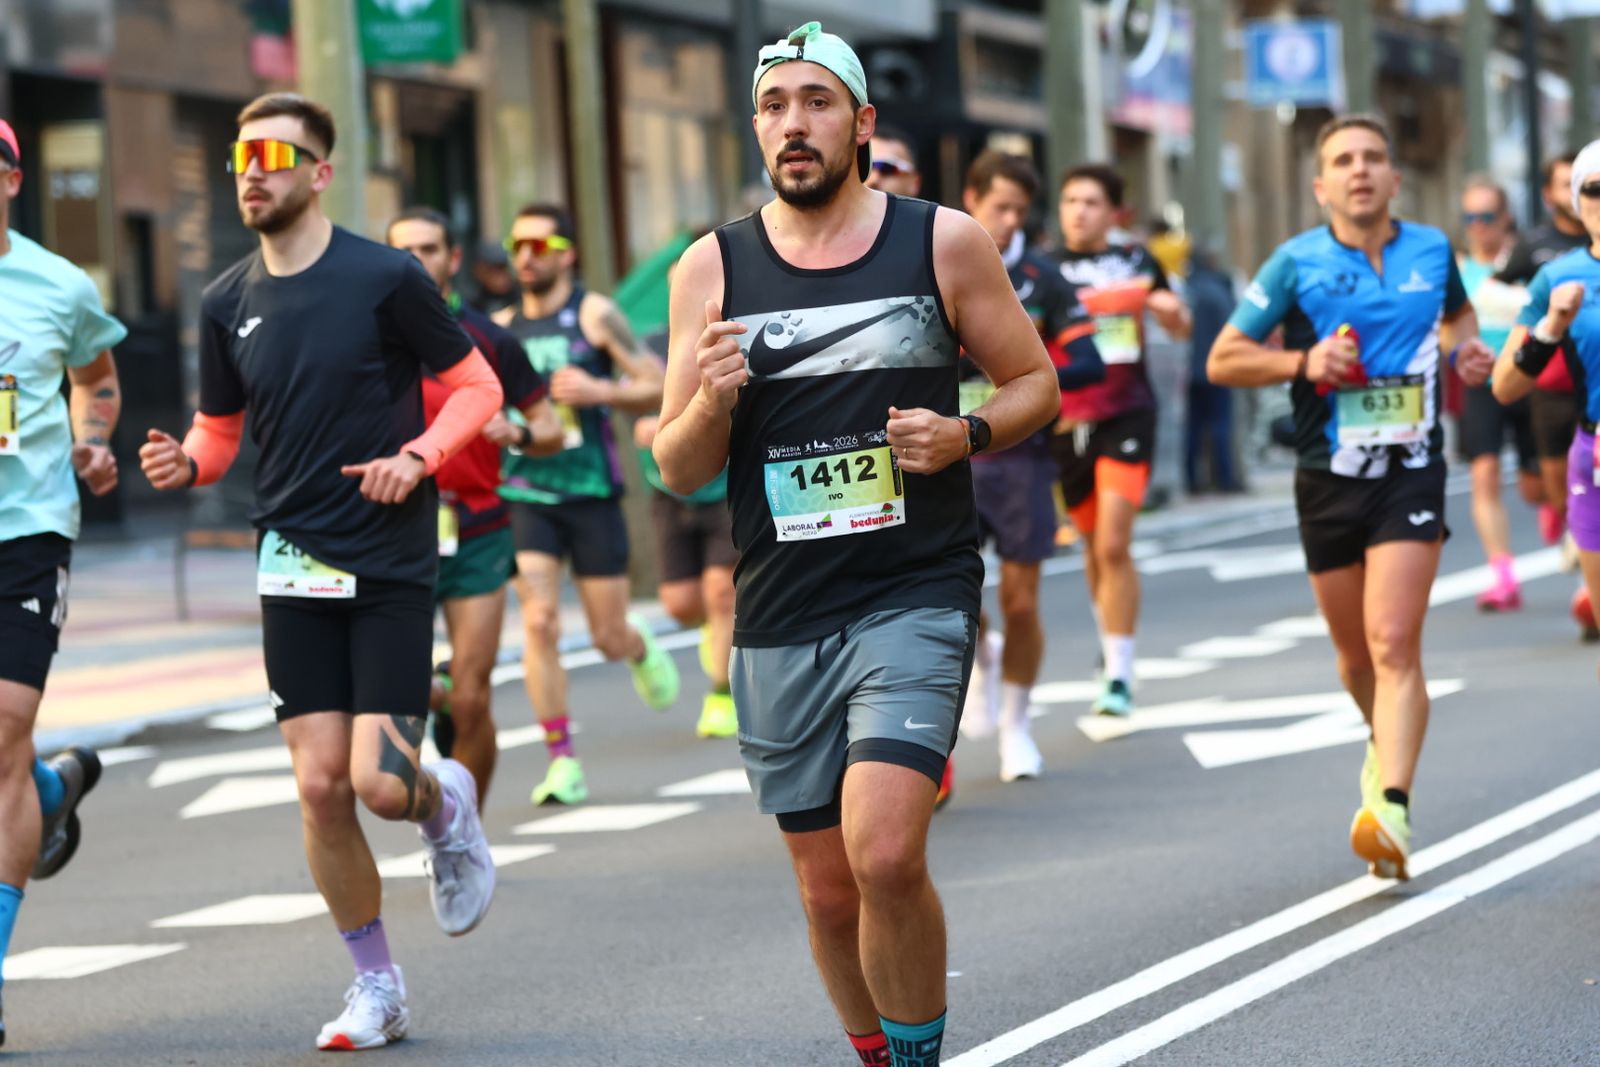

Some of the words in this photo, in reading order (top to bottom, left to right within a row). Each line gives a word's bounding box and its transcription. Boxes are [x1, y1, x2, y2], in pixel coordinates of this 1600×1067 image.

[1362, 394, 1404, 411] 633
[832, 435, 858, 448] 2026
[768, 448, 782, 460] XIV
[781, 445, 801, 453] MEDIA
[790, 454, 878, 491] 1412
[828, 492, 844, 501] IVO
[782, 522, 816, 532] LABORAL
[850, 513, 894, 529] bedunia
